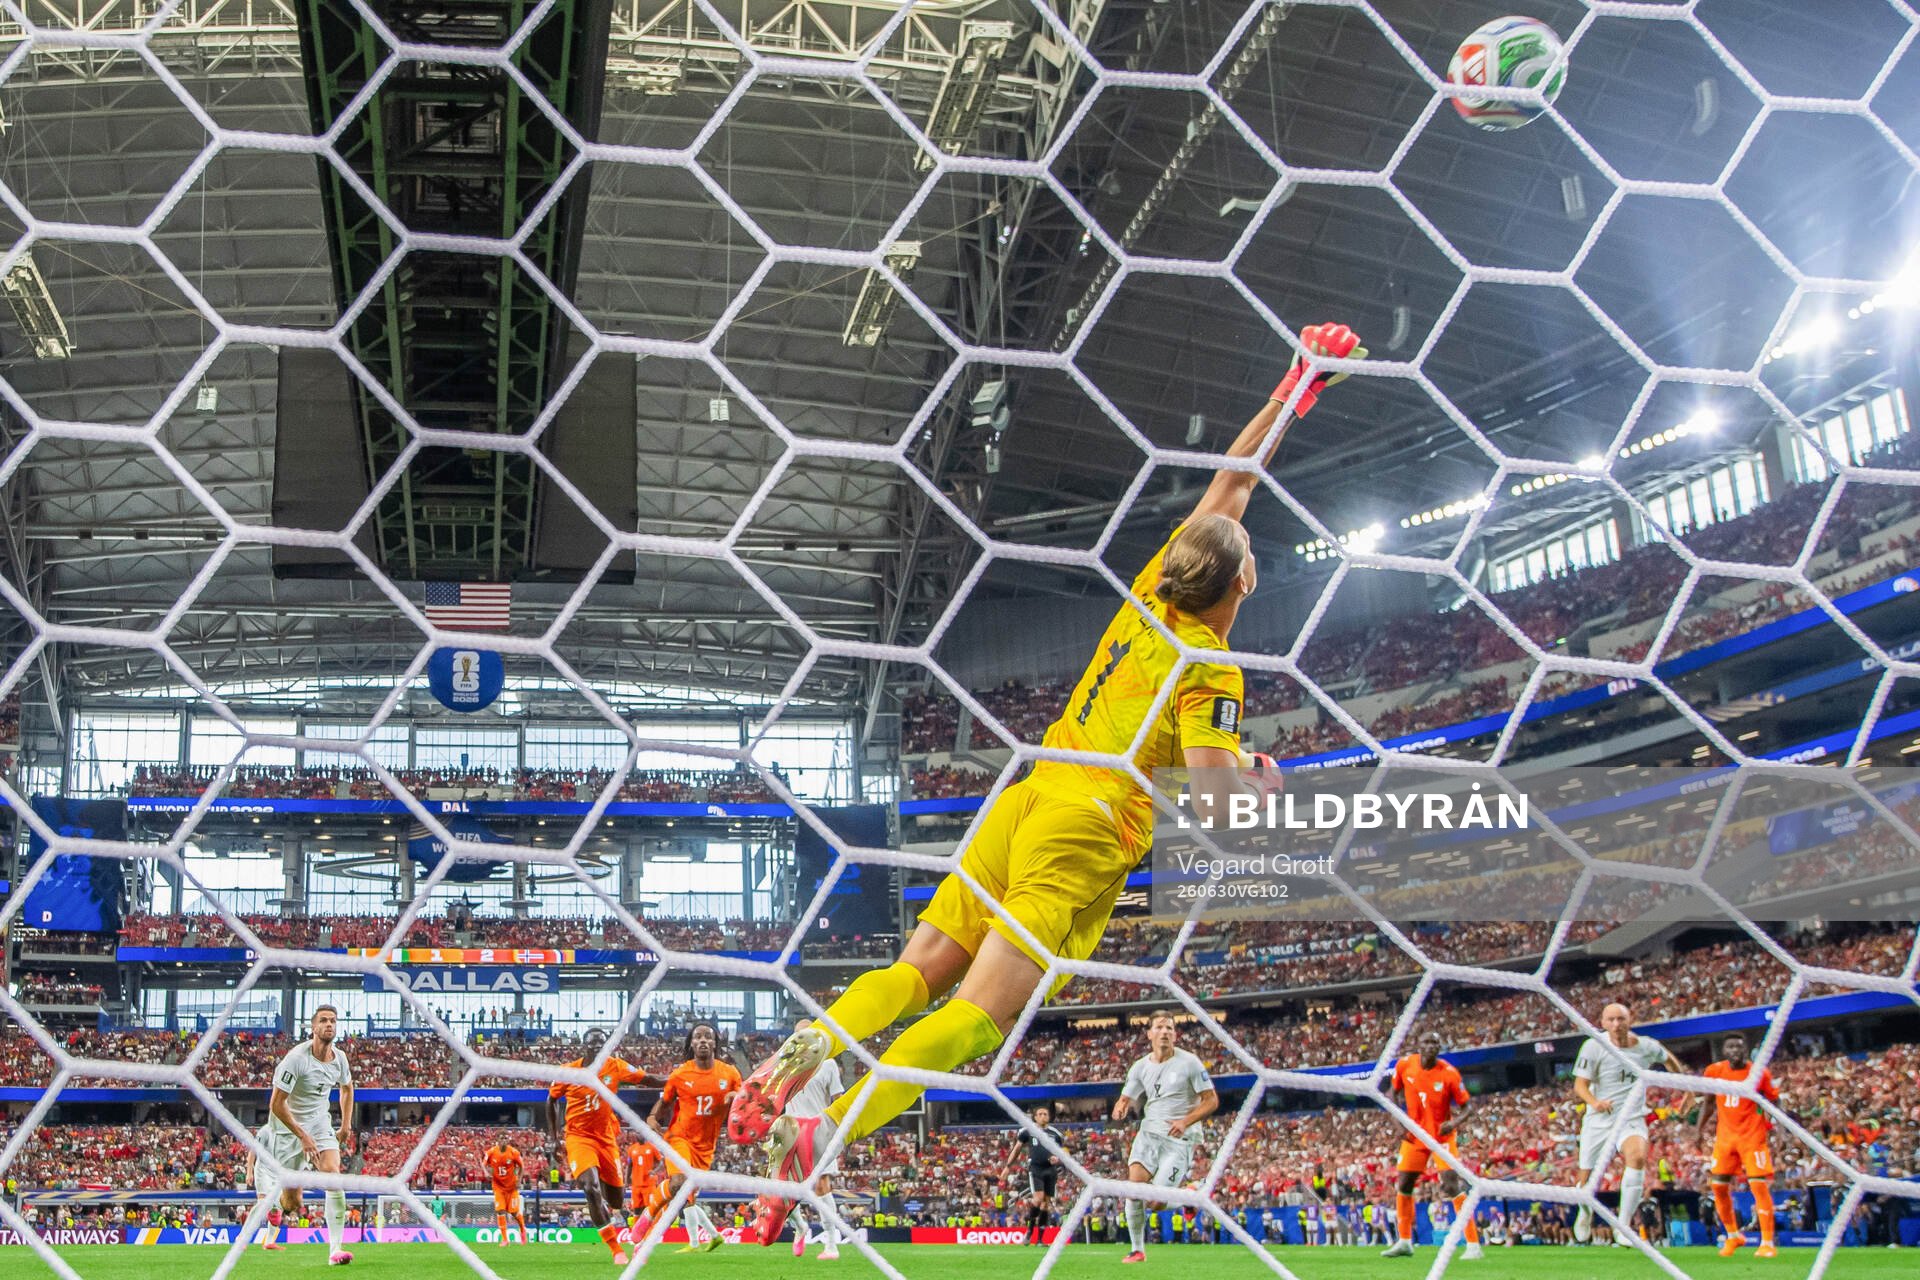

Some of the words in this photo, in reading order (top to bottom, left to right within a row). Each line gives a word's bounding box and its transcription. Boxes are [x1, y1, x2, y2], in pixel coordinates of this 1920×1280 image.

[441, 802, 470, 813] DAL
[455, 856, 489, 865] 026
[430, 950, 443, 961] 1
[480, 950, 494, 961] 2
[636, 952, 660, 962] DAL
[383, 972, 550, 992] DALLAS
[695, 1096, 713, 1116] 12
[42, 1230, 119, 1245] AIRWAYS
[180, 1228, 230, 1244] VISA
[957, 1228, 1024, 1245] Lenovo
